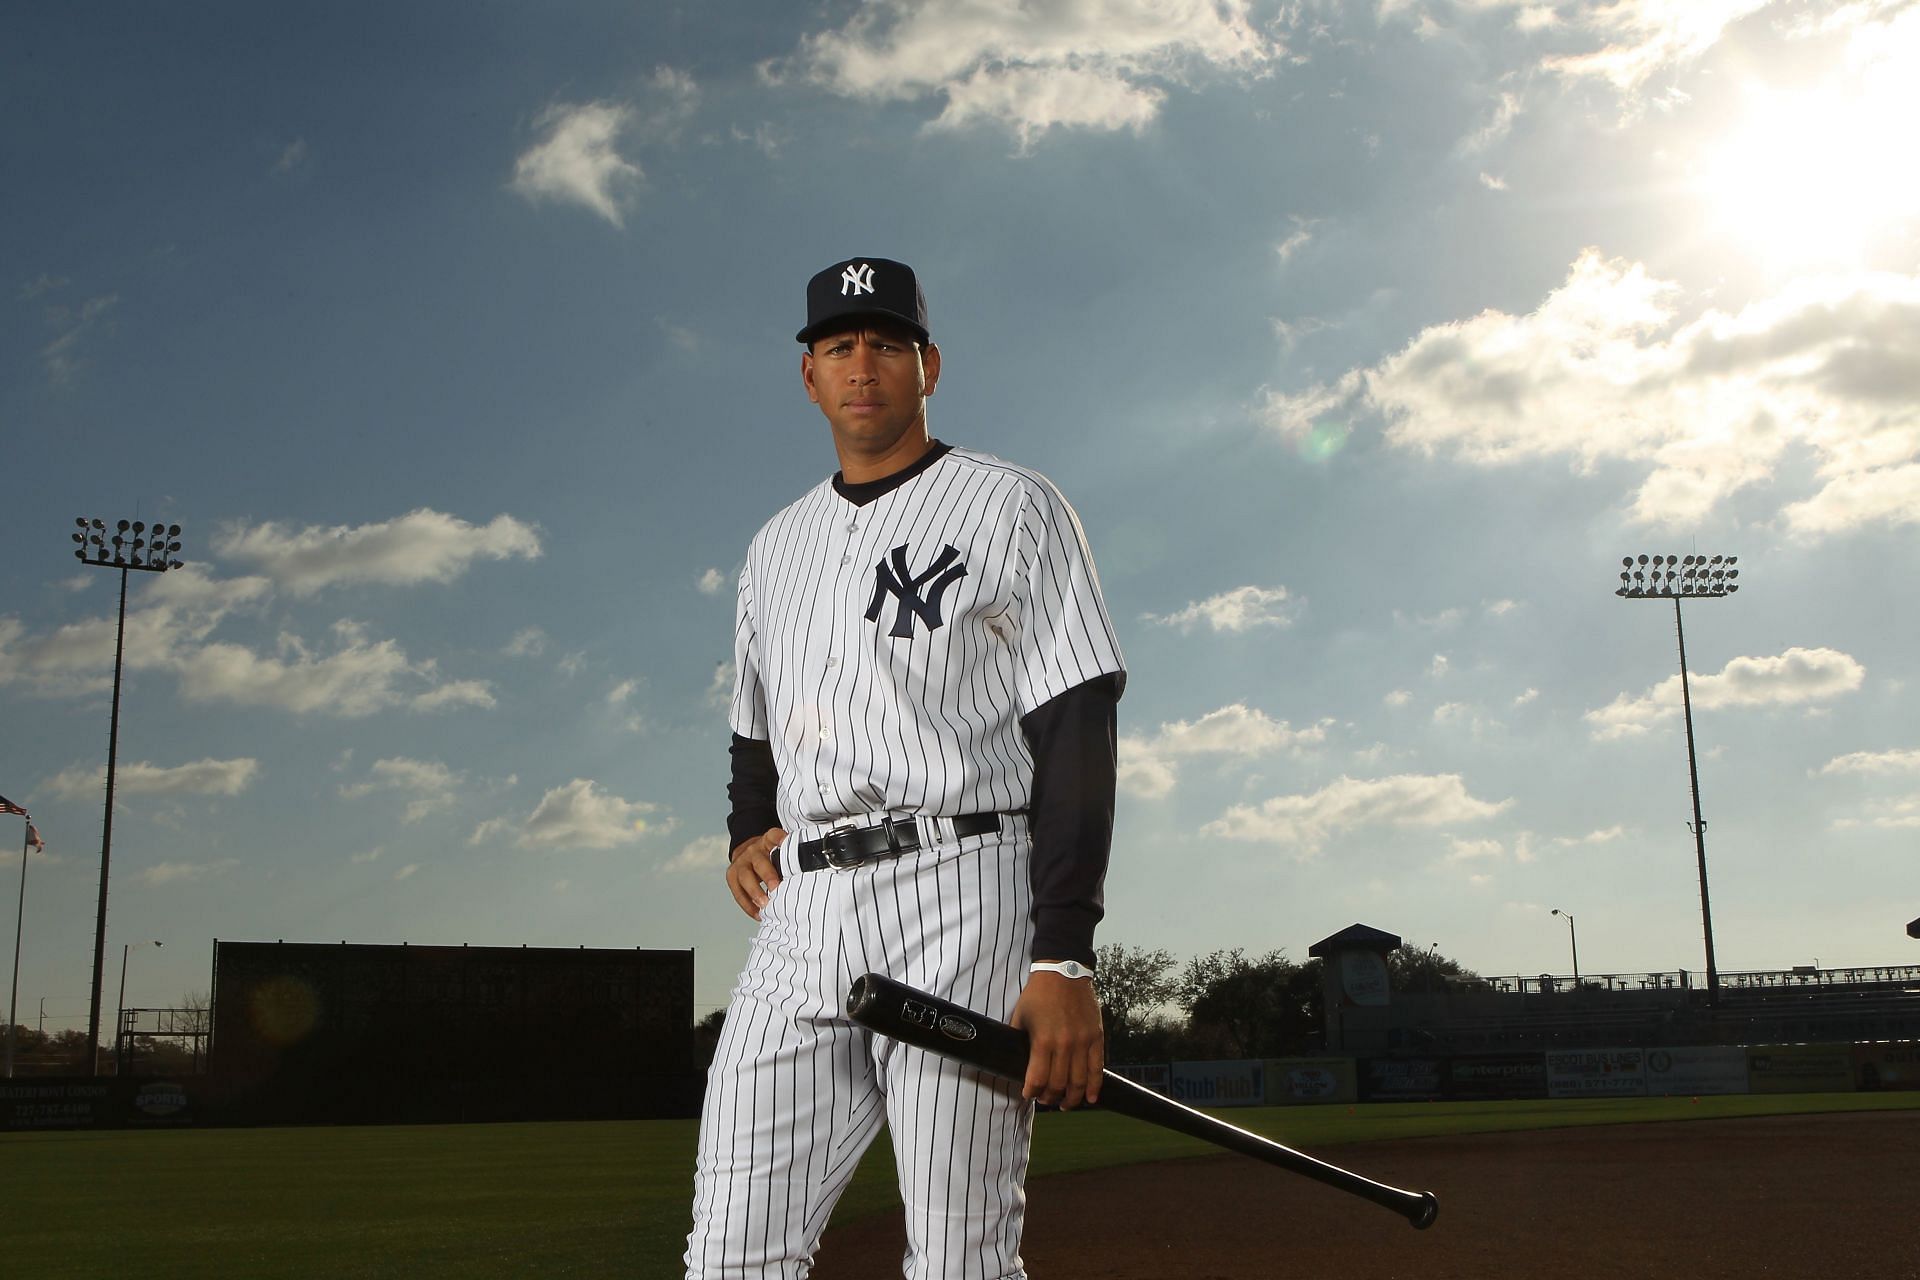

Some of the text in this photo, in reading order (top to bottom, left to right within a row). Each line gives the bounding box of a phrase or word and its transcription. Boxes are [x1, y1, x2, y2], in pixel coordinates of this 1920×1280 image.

[841, 263, 875, 296] NY
[864, 542, 969, 640] NY
[1453, 1063, 1543, 1076] enterprise
[1548, 1054, 1582, 1065] ESCOT
[1584, 1053, 1608, 1064] BUS
[1174, 1067, 1261, 1099] StubHub!
[136, 1094, 187, 1105] SPORTS
